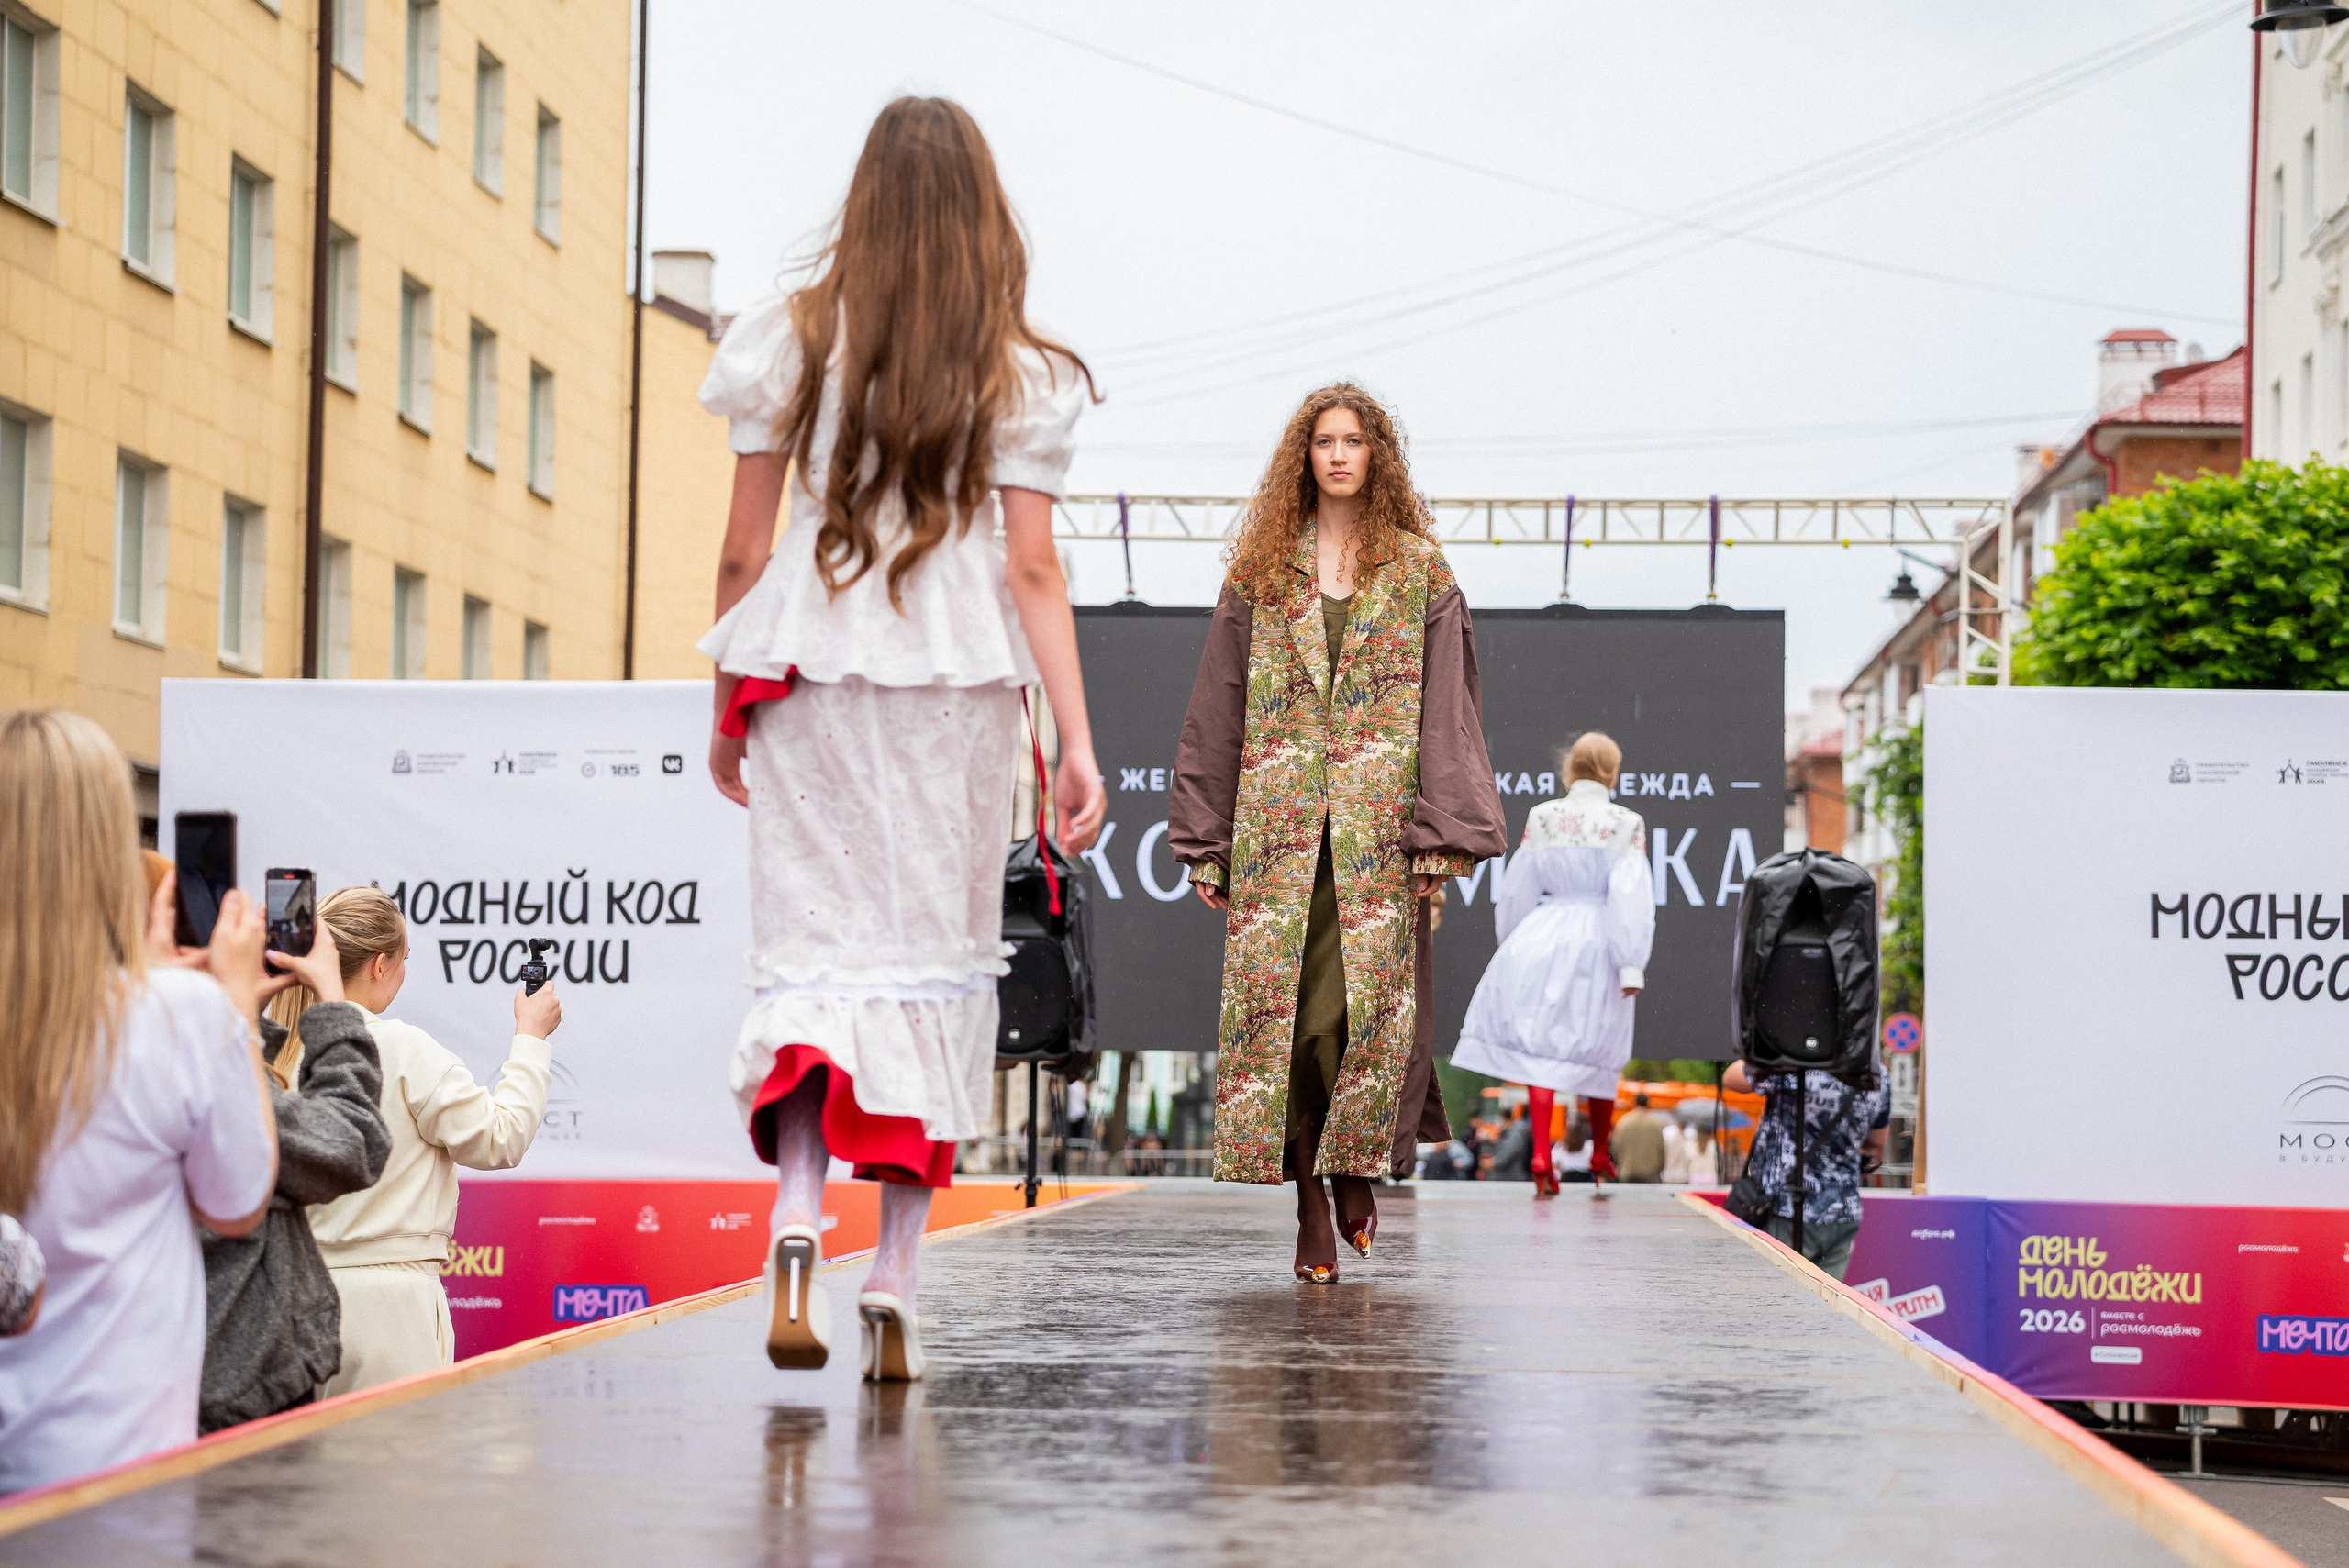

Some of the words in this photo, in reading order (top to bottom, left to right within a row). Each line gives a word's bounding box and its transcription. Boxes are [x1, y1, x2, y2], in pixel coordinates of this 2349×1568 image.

[1494, 771, 1556, 795] КАЯ
[1609, 772, 1715, 801] ЕЖДА
[607, 880, 701, 925] КОД
[543, 1110, 584, 1128] СТ
[2279, 1132, 2349, 1150] МО
[2020, 1308, 2087, 1334] 2026
